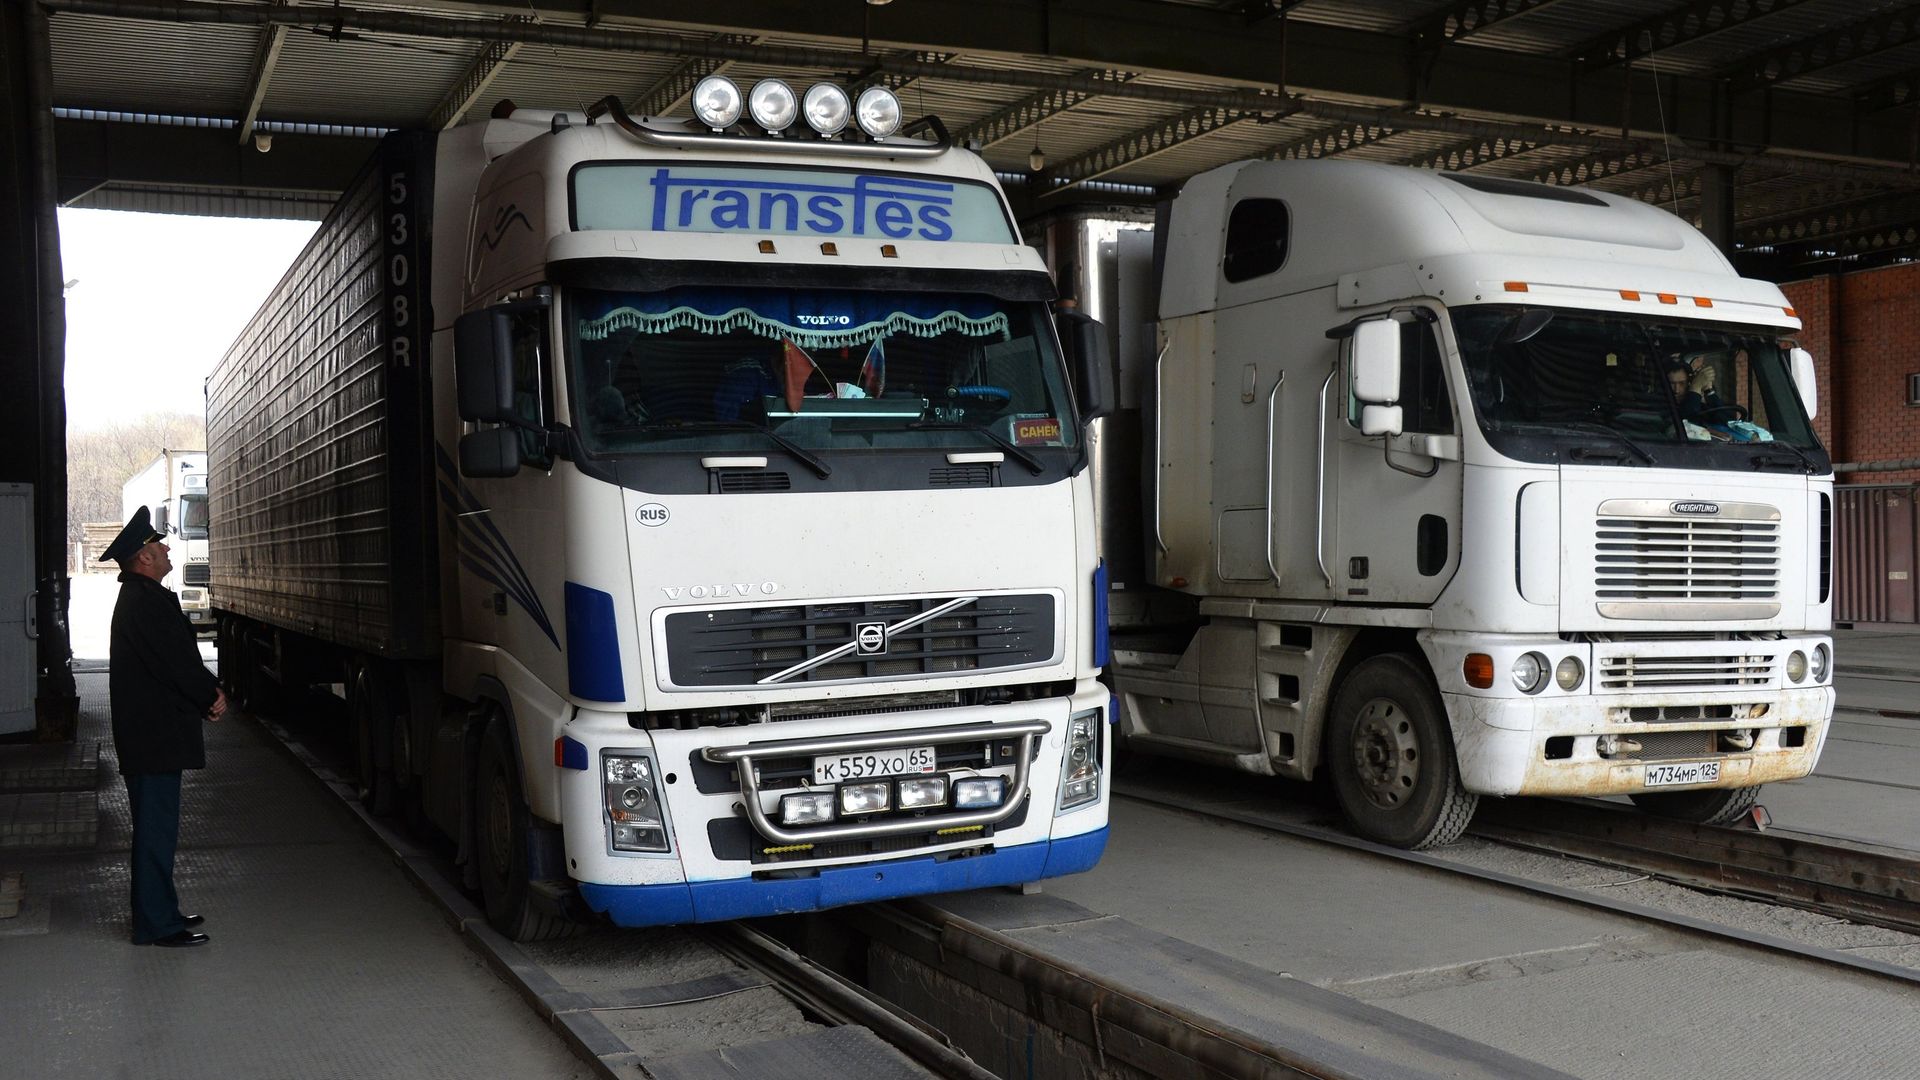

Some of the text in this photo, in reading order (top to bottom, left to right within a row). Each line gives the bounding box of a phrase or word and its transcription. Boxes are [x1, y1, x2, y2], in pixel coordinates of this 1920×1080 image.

[797, 315, 850, 325] VOLVO
[1020, 425, 1057, 438] САНЕК
[640, 509, 666, 520] RUS
[1676, 503, 1718, 513] FREIGHTLINER
[661, 581, 778, 600] VOLVO
[909, 750, 928, 766] 65
[1700, 763, 1717, 776] 125
